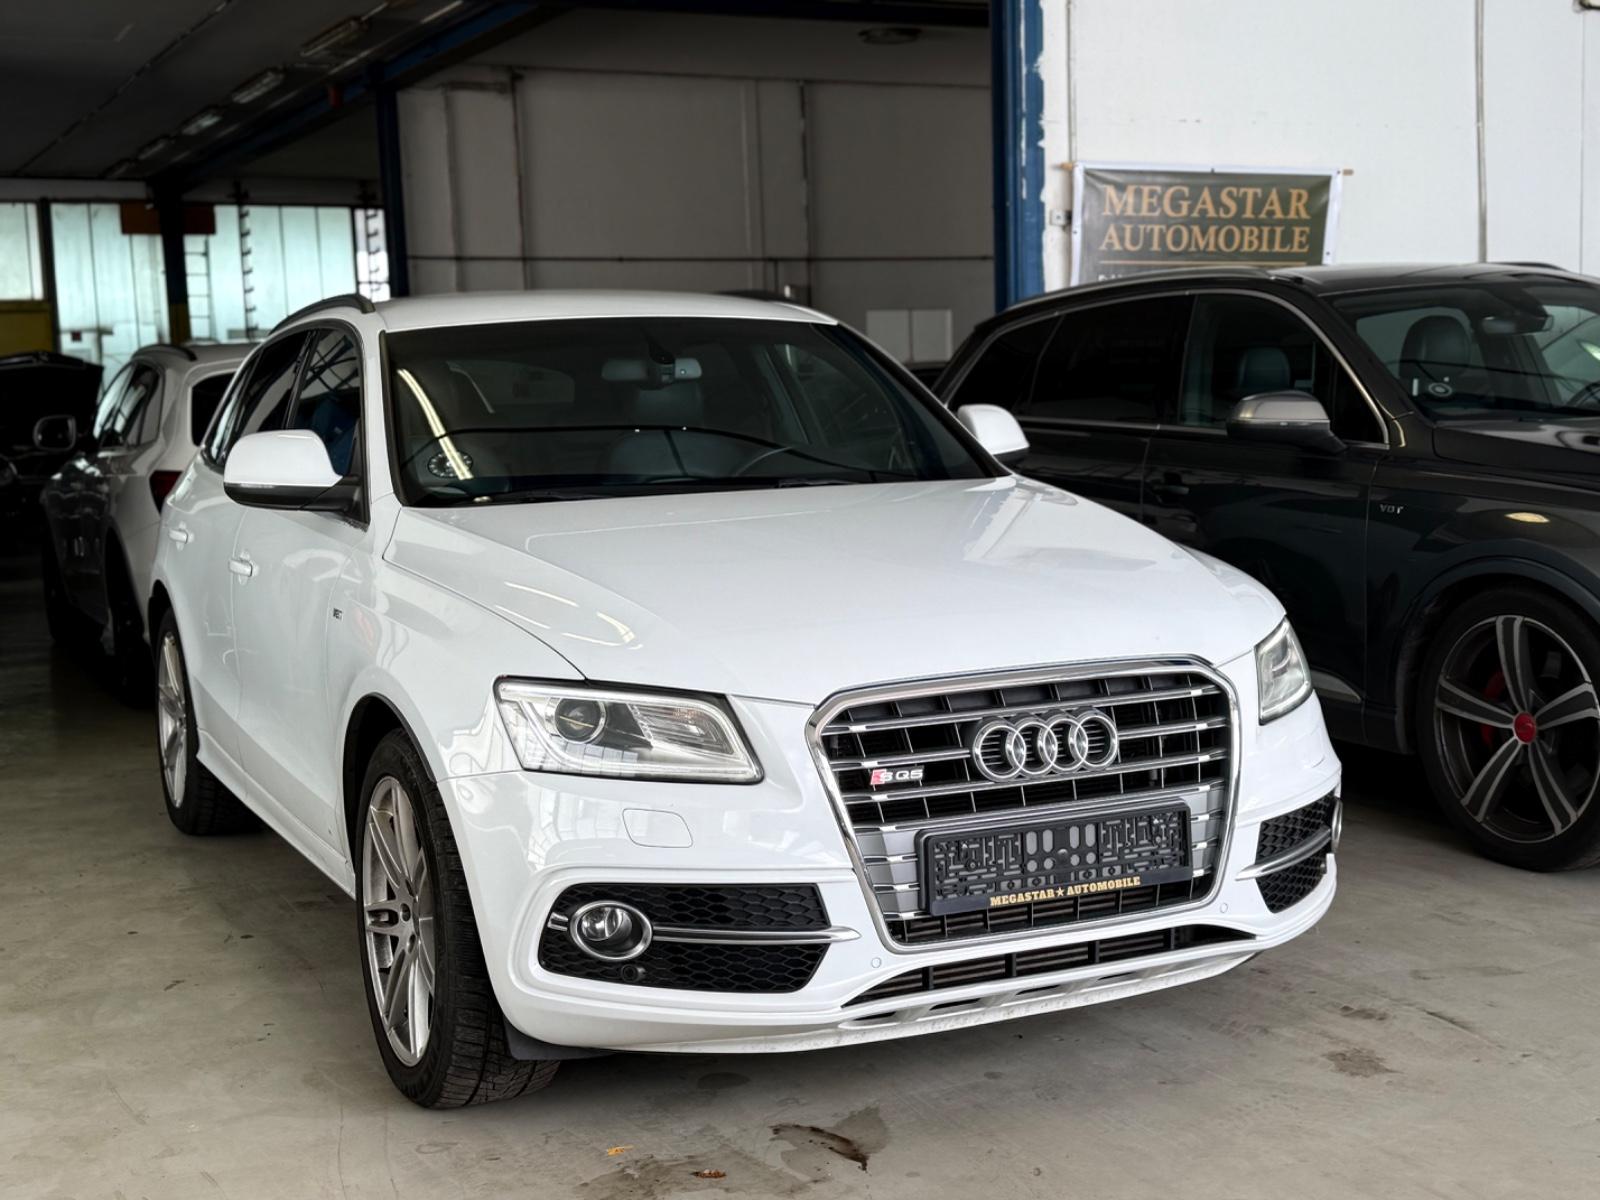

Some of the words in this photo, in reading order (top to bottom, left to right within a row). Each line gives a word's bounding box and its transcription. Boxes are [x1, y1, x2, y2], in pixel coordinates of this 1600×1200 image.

[1100, 184, 1311, 220] MEGASTAR
[1099, 224, 1310, 253] AUTOMOBILE
[989, 888, 1055, 907] MEGASTAR
[1066, 875, 1142, 896] AUTOMOBILE
